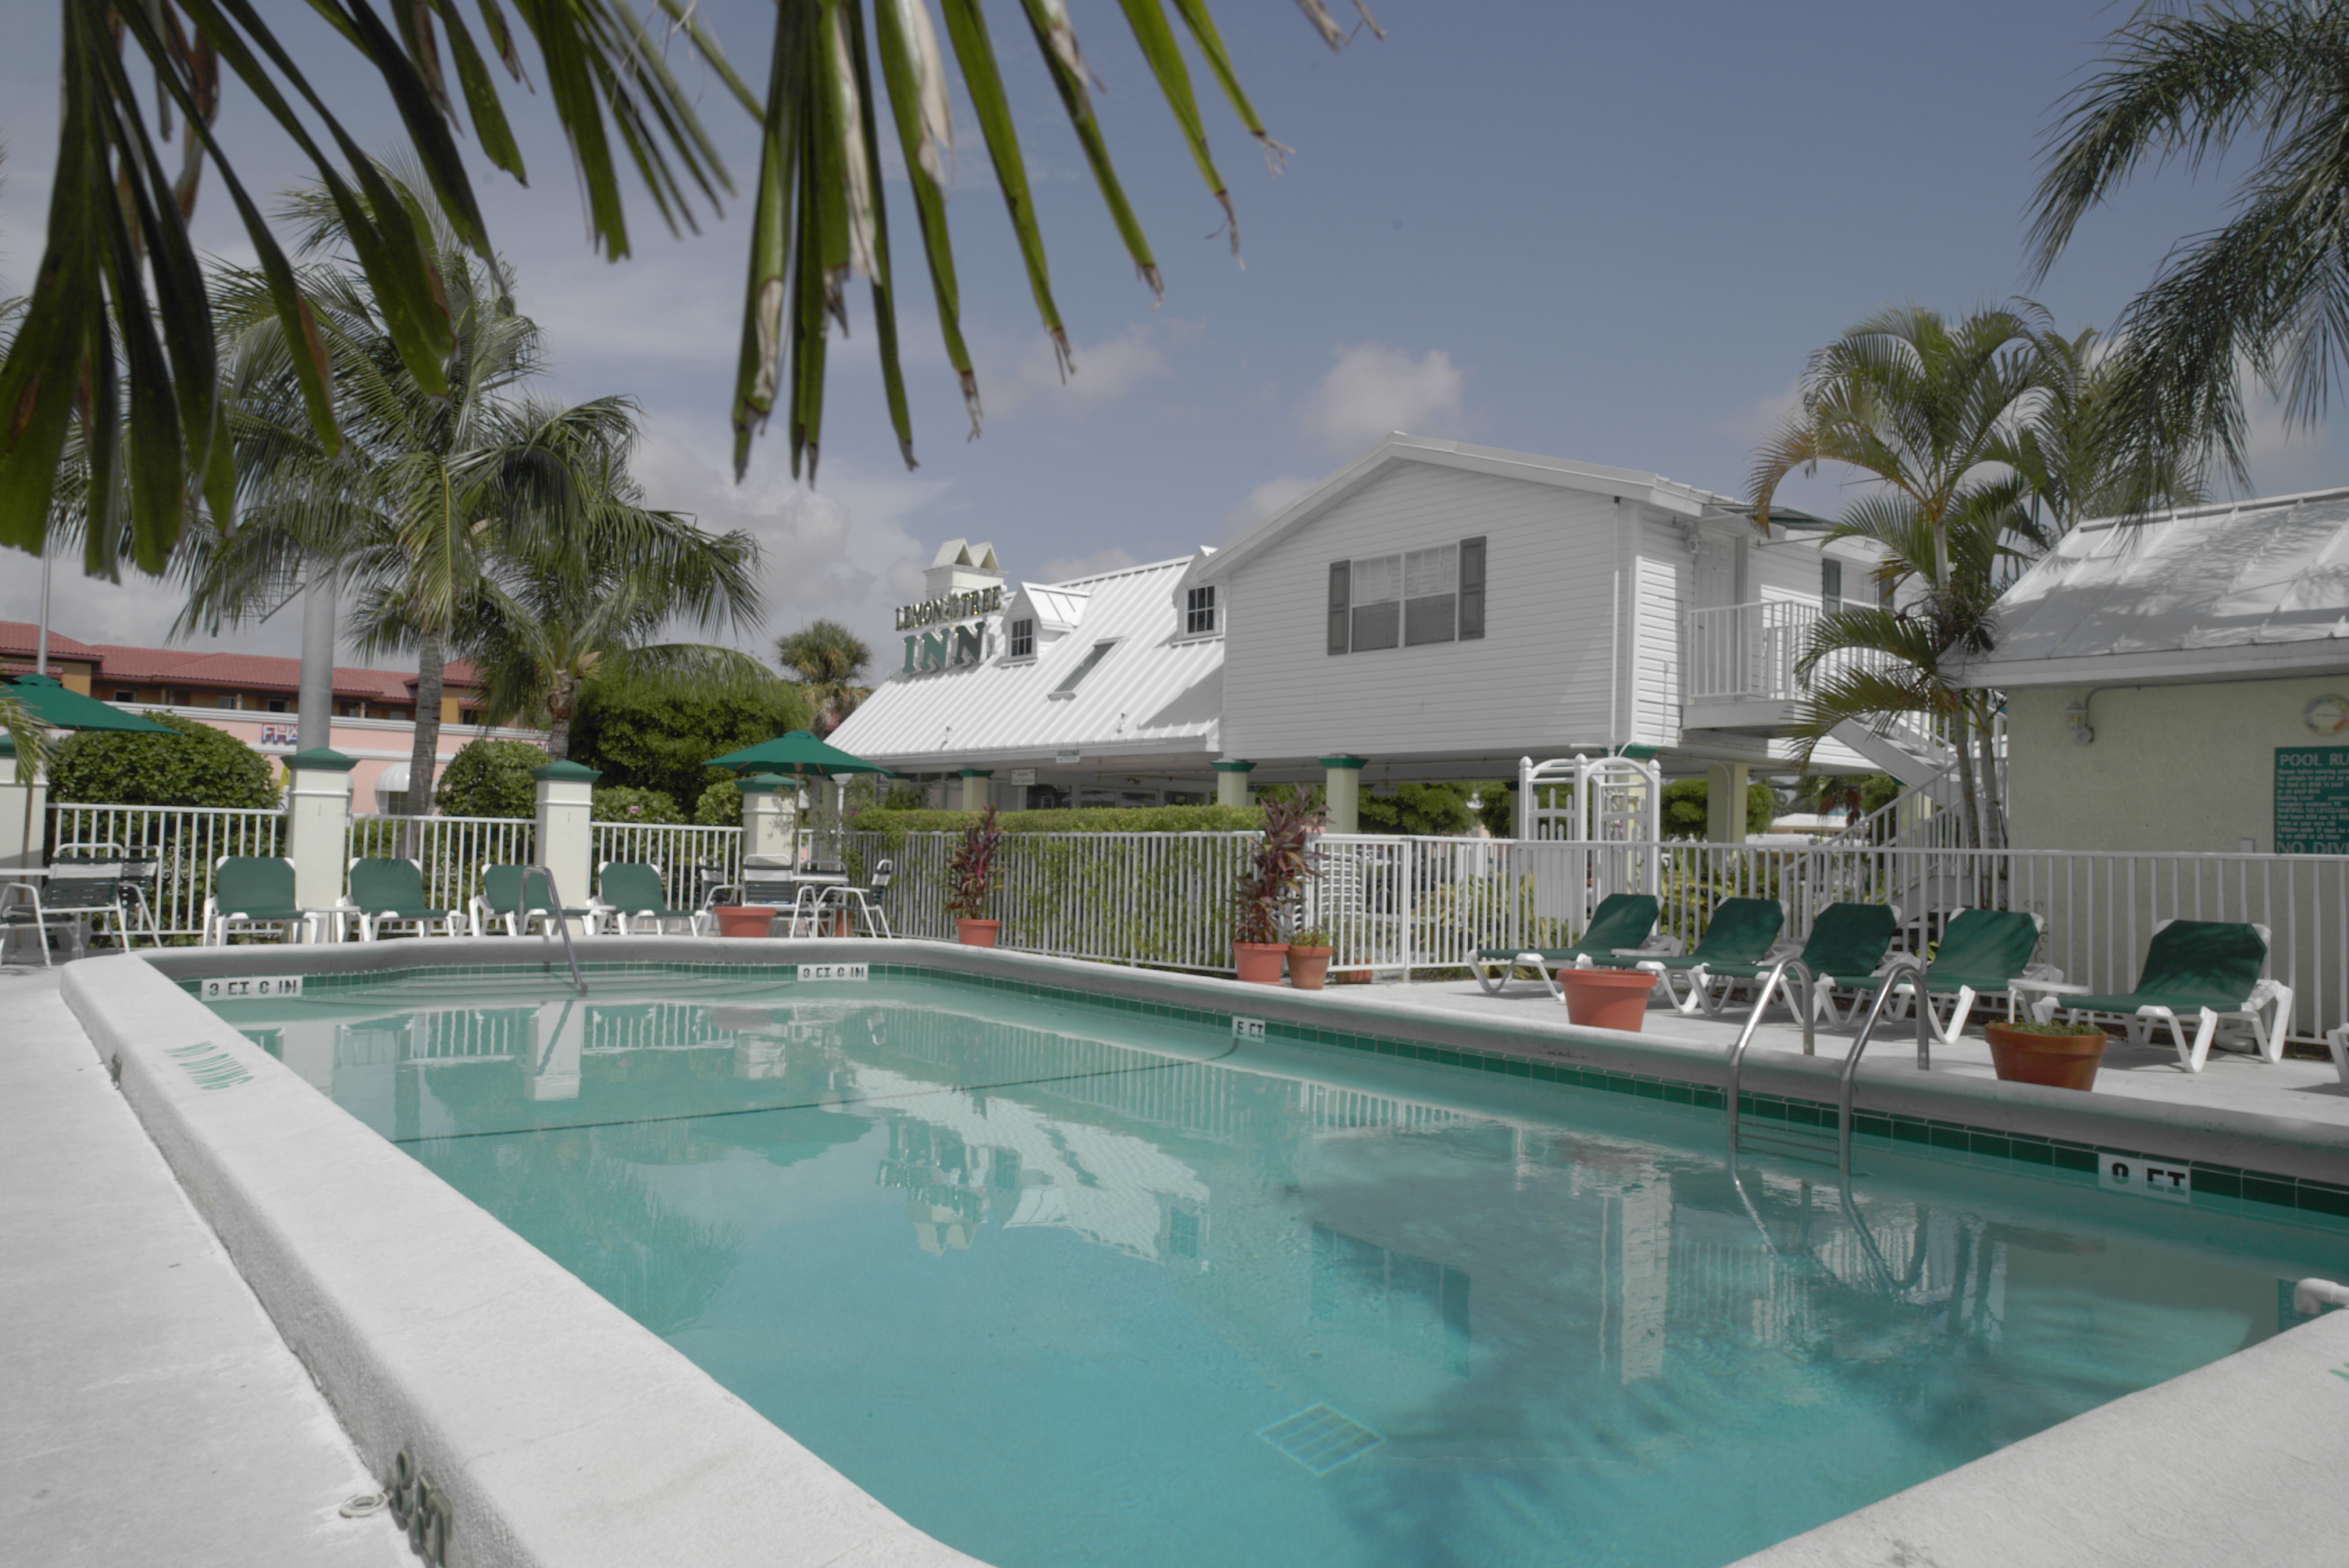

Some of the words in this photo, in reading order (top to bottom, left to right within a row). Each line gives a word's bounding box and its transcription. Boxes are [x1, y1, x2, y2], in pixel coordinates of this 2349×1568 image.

[896, 599, 943, 631] LEMON
[961, 586, 1001, 617] TREE
[902, 622, 986, 673] INN
[2279, 754, 2322, 766] POOL
[2276, 841, 2305, 853] NO
